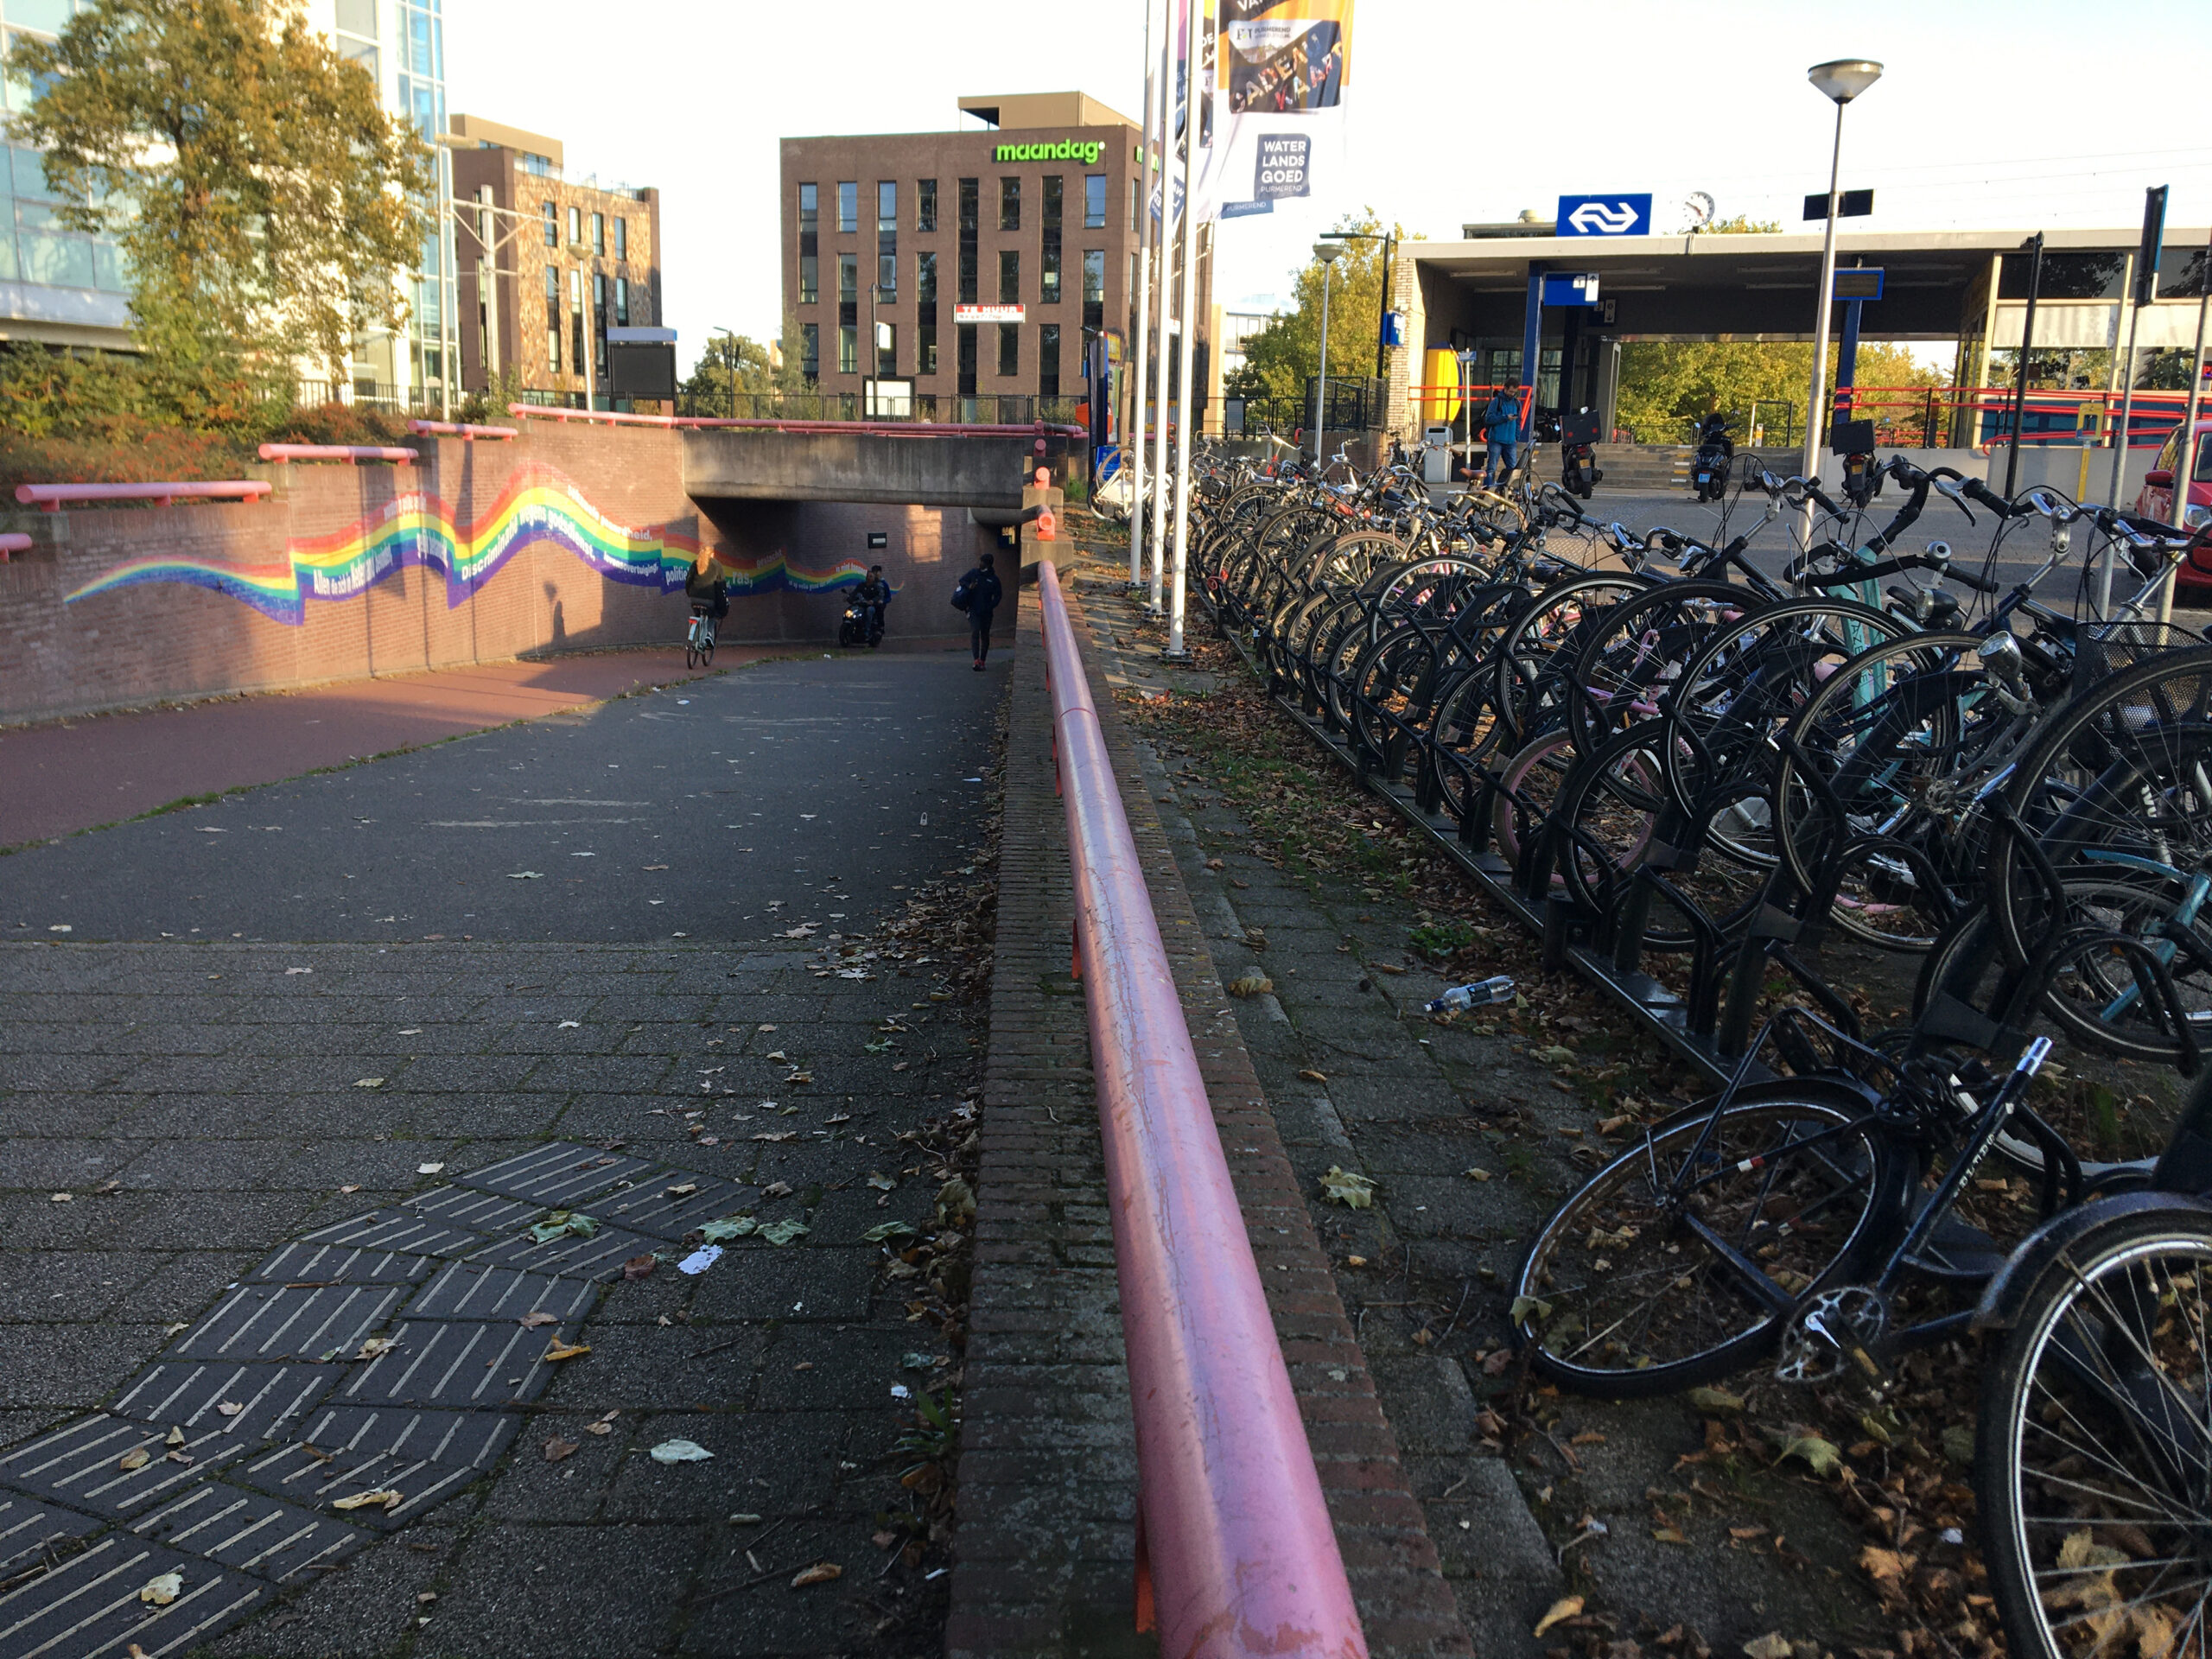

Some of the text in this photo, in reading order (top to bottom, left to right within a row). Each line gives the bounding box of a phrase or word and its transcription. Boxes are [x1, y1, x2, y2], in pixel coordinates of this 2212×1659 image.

[1236, 0, 1263, 11] VA
[996, 138, 1099, 164] maandag
[1263, 140, 1306, 152] WATER
[1262, 155, 1306, 168] LANDS
[1261, 169, 1304, 184] GOED
[1260, 184, 1303, 193] PURMEREND
[1227, 201, 1267, 212] PURMEREND
[461, 512, 518, 582] Discriminatie
[665, 566, 690, 586] politie
[732, 570, 753, 588] ras,
